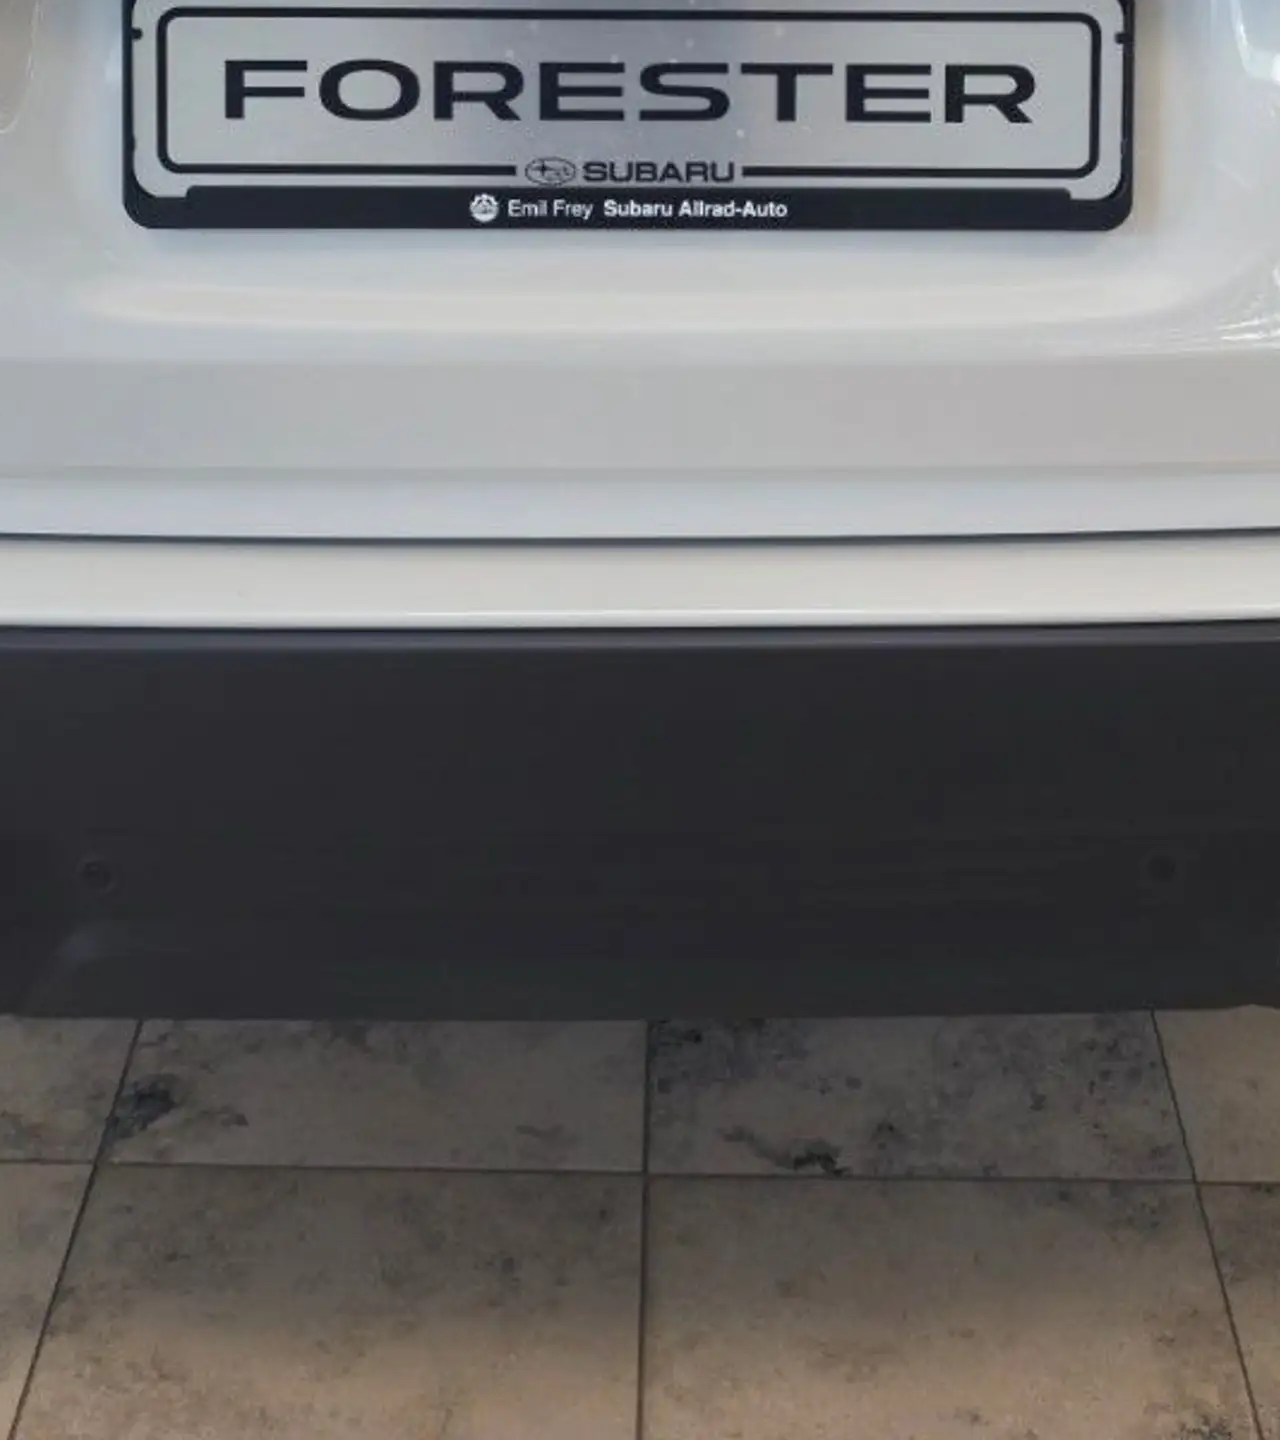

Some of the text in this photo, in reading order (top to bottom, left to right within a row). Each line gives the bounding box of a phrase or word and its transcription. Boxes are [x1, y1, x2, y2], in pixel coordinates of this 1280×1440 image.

[223, 57, 1039, 124] FORESTER
[582, 161, 735, 183] SUBARU
[508, 198, 788, 221] Emil Frey Subaru Allrad-Auto
